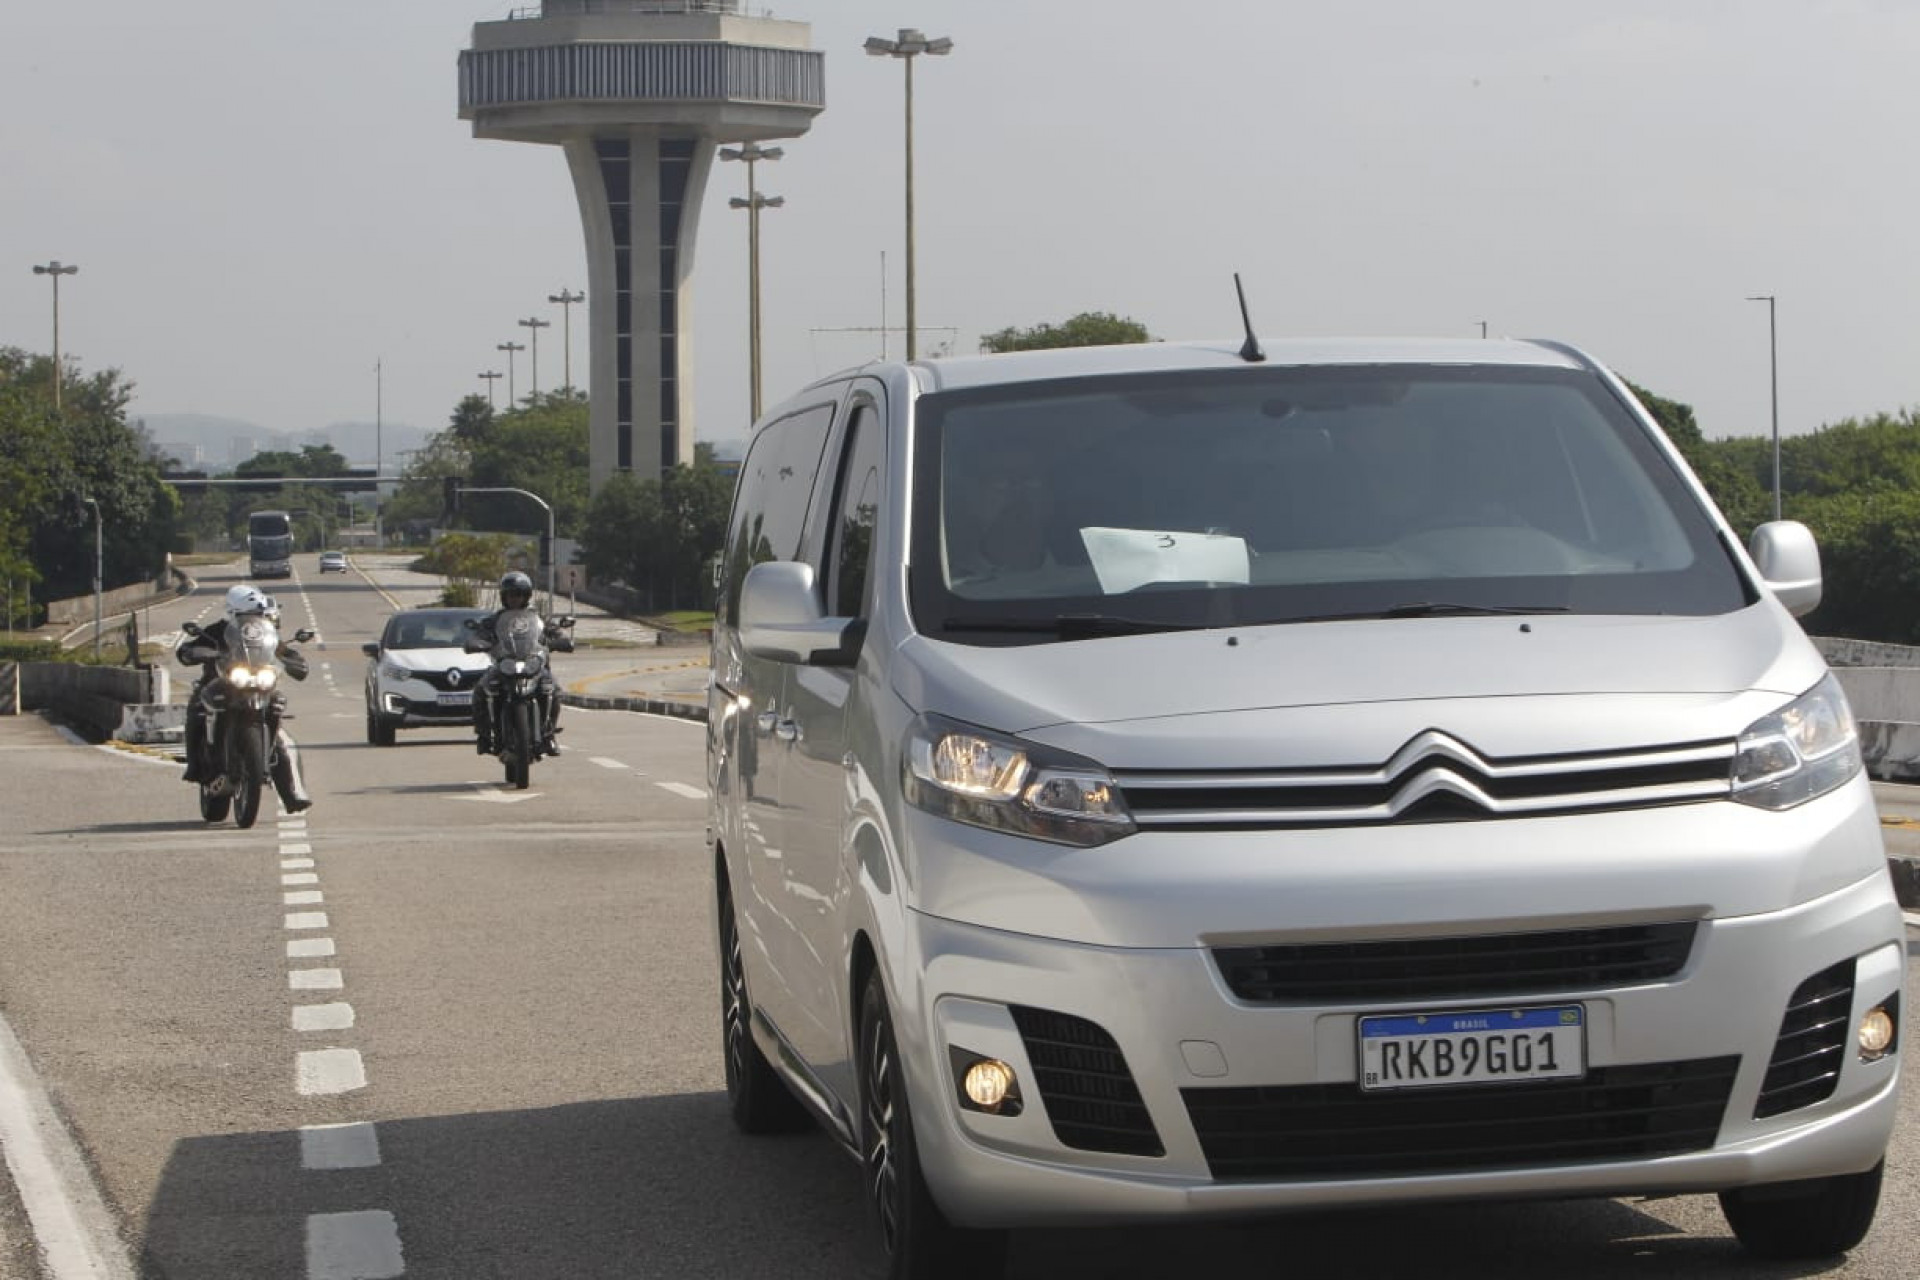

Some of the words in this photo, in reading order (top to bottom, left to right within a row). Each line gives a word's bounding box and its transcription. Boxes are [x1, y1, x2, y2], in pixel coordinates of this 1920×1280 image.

[1155, 534, 1176, 549] 3
[1453, 1019, 1489, 1030] BRASIL
[1381, 1032, 1558, 1080] RKB9G01
[1366, 1072, 1378, 1085] BR
